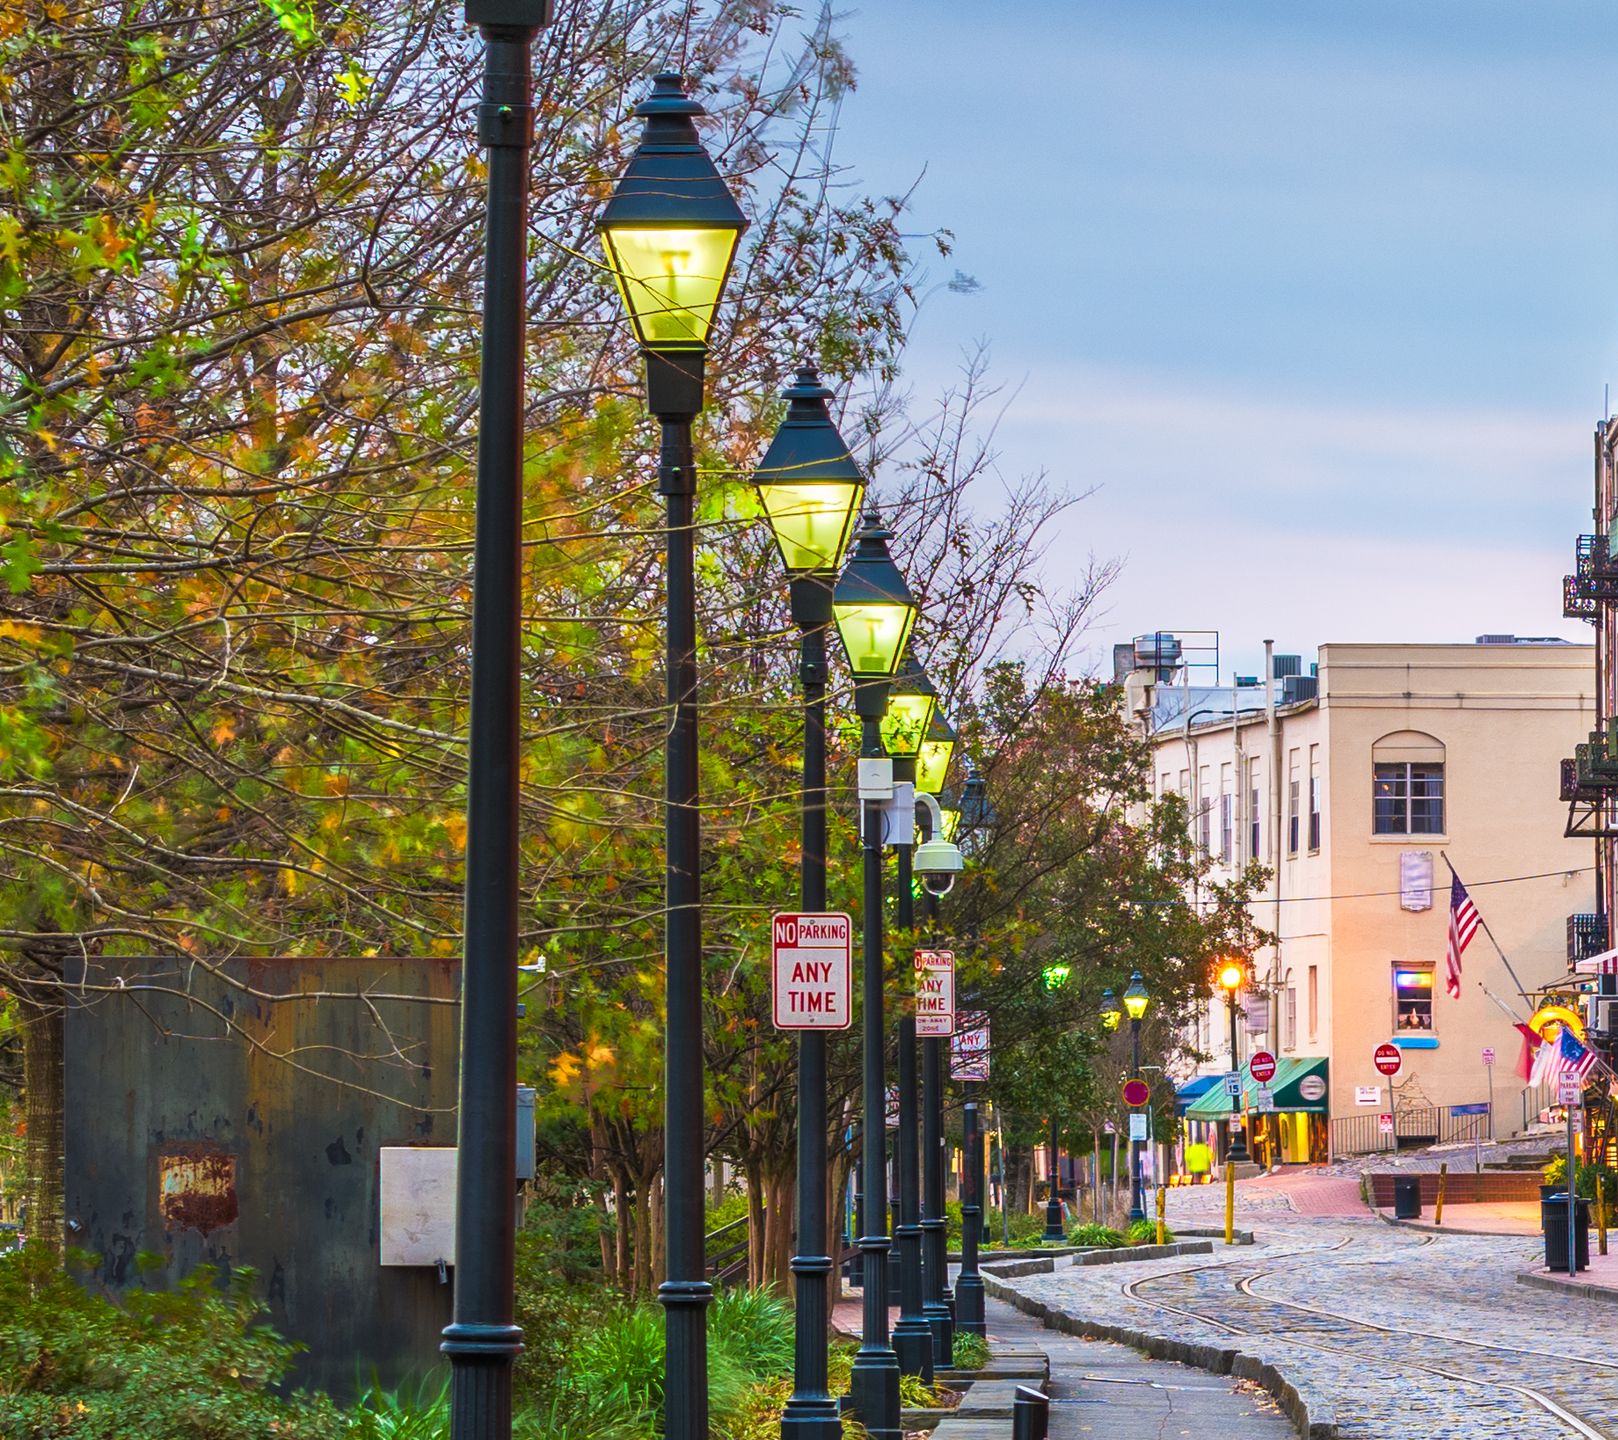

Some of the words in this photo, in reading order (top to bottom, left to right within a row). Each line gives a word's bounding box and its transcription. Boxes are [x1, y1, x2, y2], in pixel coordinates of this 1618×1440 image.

[776, 922, 796, 944] NO
[799, 924, 846, 939] PARKING
[791, 962, 833, 983] ANY
[920, 980, 943, 992] ANY
[788, 991, 836, 1013] TIME
[916, 997, 946, 1010] TIME
[1228, 1084, 1239, 1093] 15
